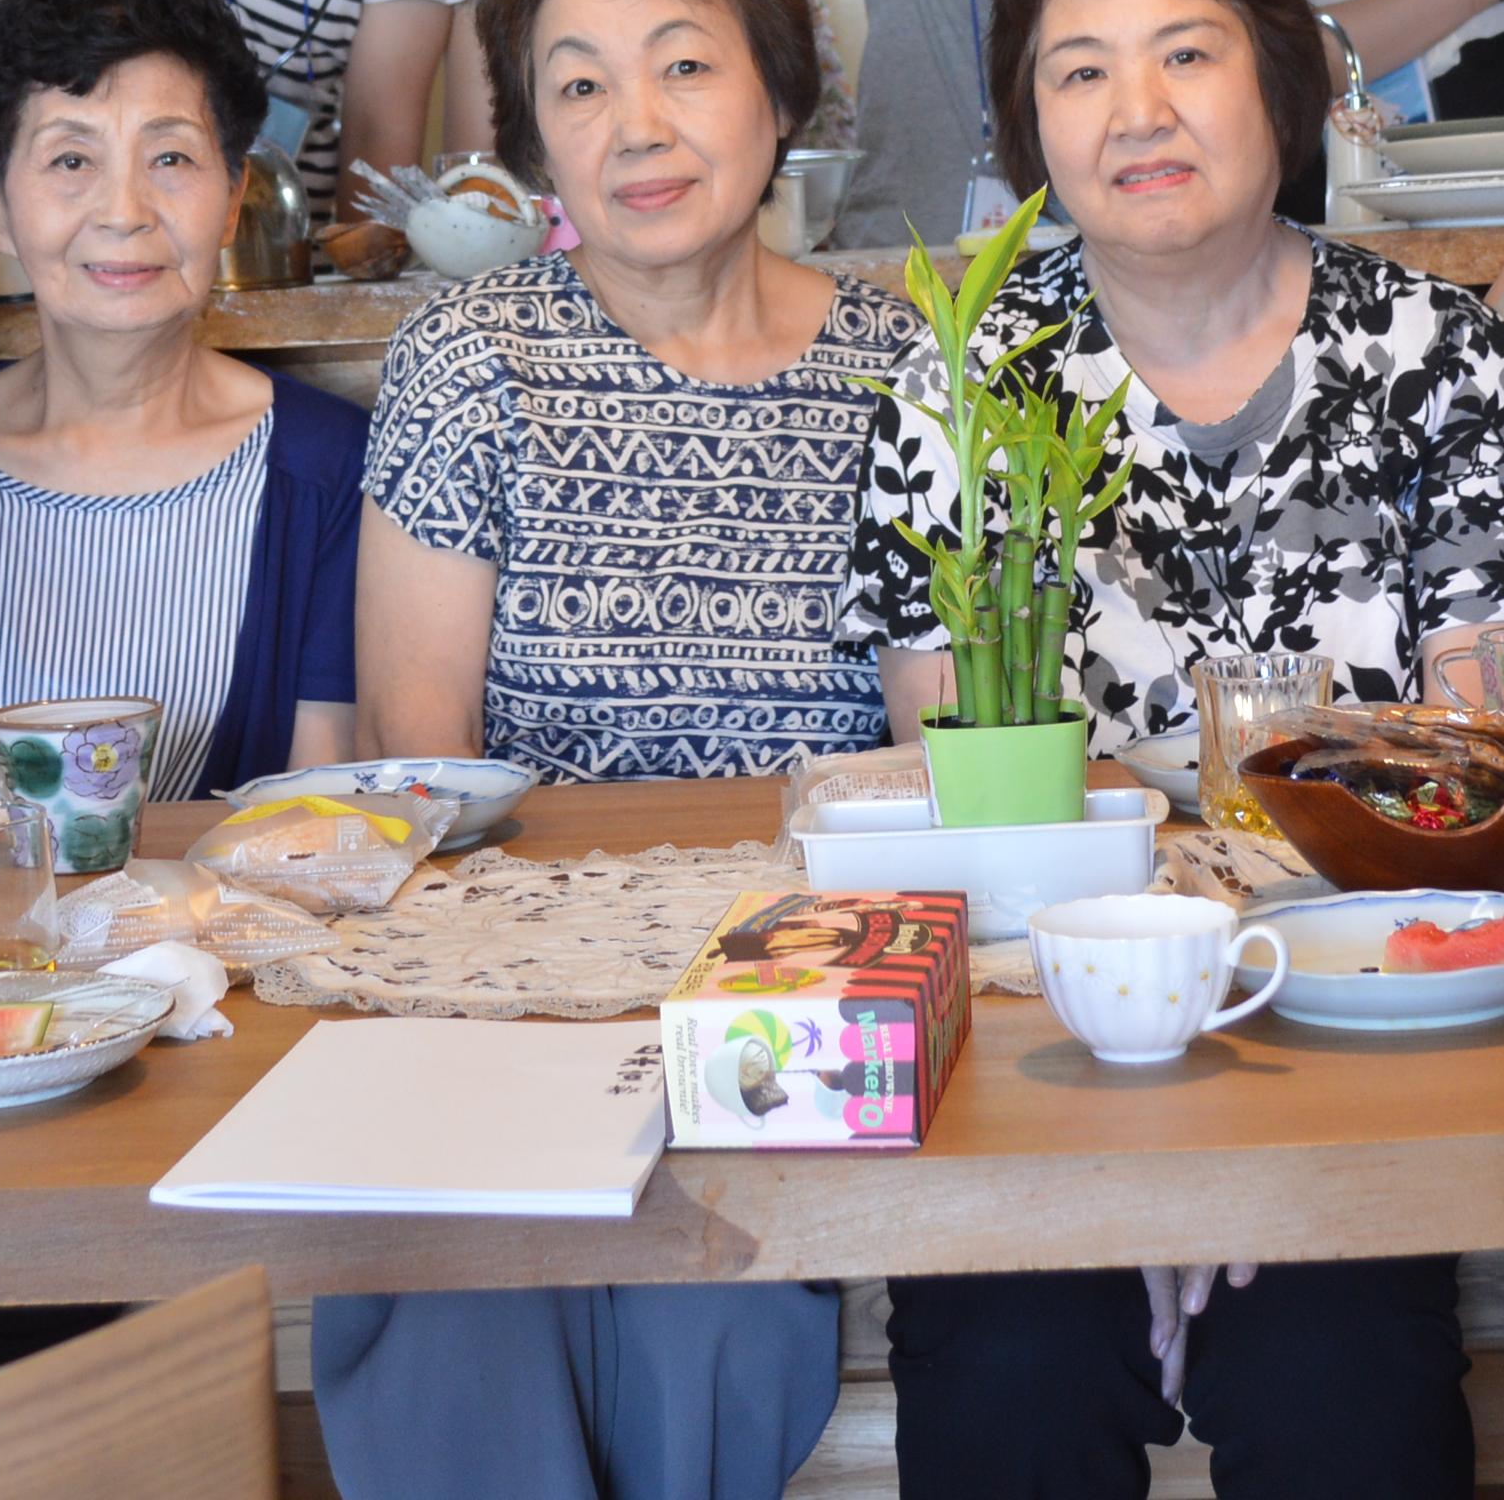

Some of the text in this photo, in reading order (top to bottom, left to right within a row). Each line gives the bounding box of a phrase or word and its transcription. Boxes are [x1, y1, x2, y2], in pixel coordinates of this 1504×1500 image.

[675, 1023, 690, 1115] real brownie!
[686, 1016, 702, 1125] Real love makes
[857, 1009, 885, 1128] Market O
[880, 1023, 898, 1114] REAL BROWNIE
